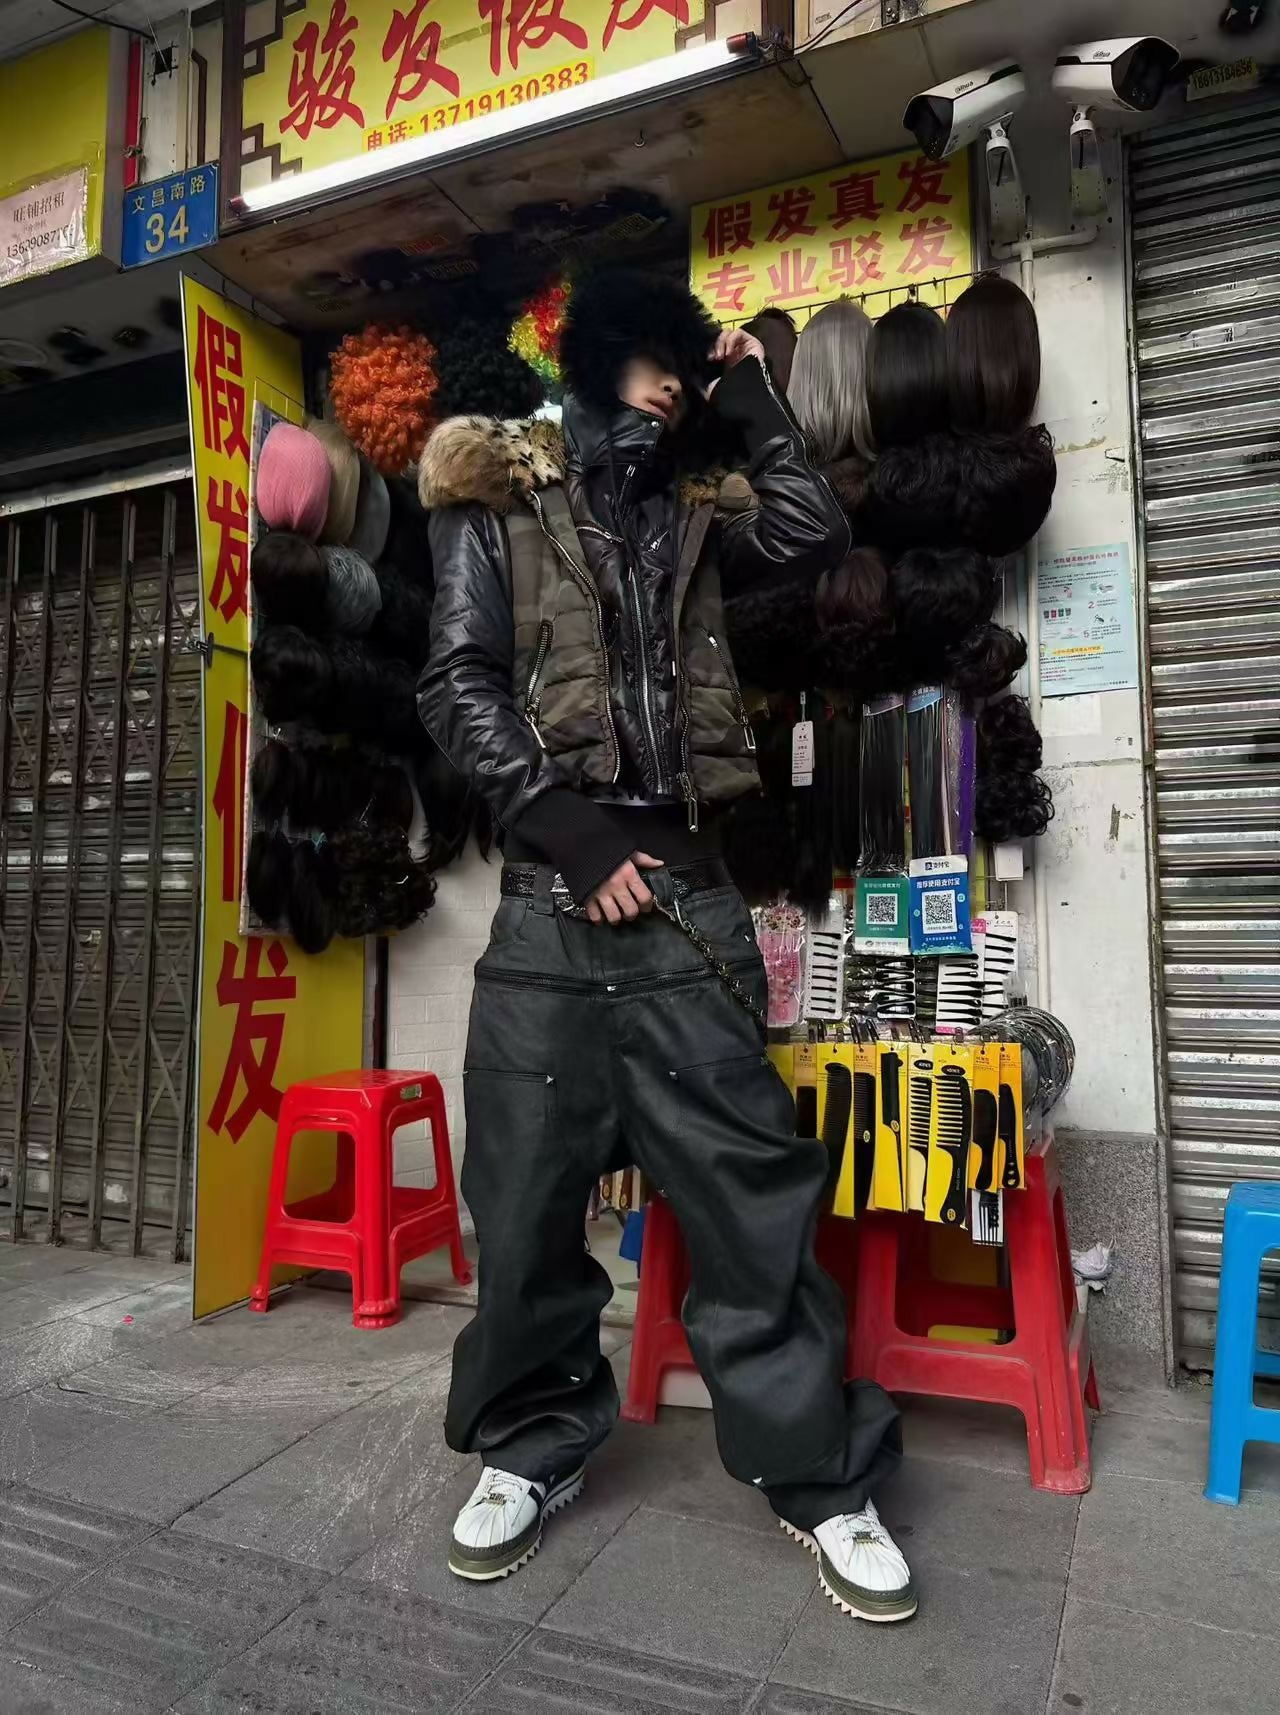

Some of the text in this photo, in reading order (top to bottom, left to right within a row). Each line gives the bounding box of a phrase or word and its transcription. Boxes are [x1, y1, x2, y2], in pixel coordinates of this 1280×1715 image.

[420, 62, 589, 133] 13719130383
[13, 191, 65, 222] 旺铺招租
[132, 175, 206, 214] 文昌南路
[702, 155, 953, 259] 假发真发
[145, 204, 189, 254] 34
[702, 216, 956, 312] 专业驳发
